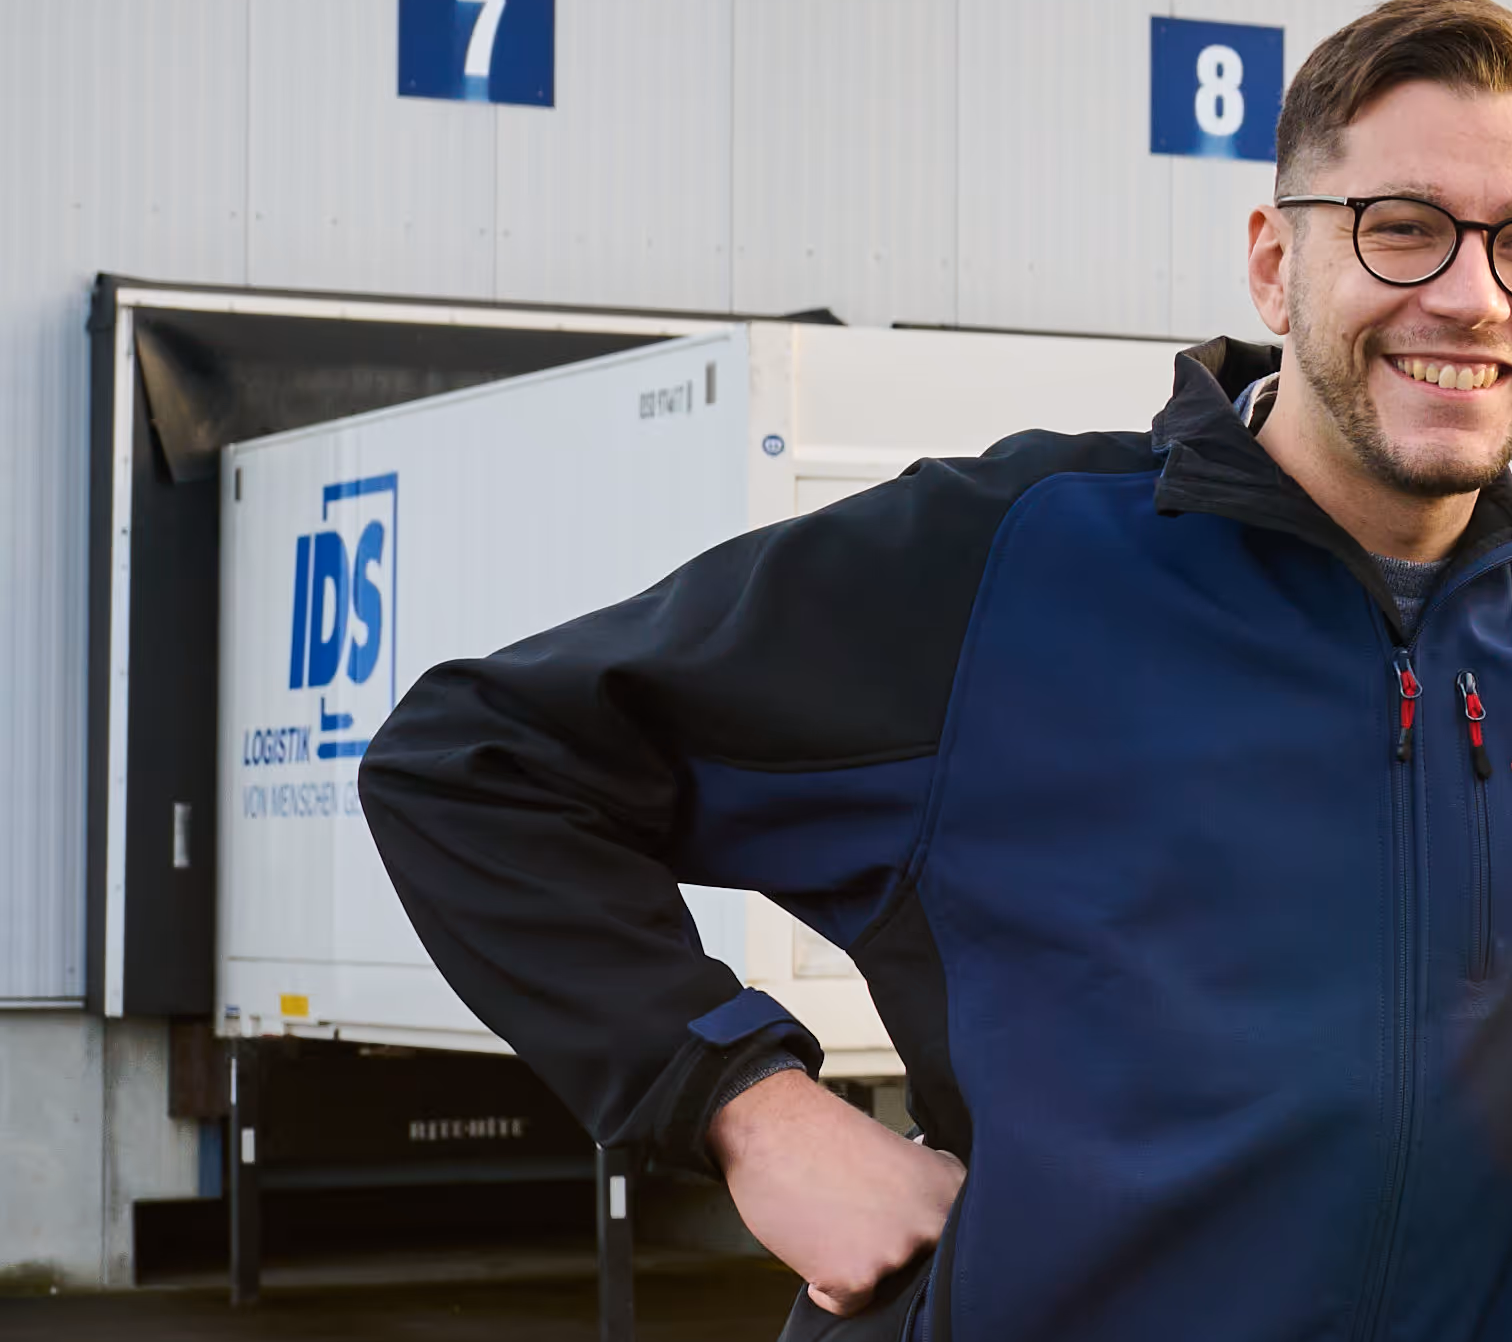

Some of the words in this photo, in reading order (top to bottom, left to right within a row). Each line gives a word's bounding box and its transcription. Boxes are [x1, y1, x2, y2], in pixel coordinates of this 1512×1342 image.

[1194, 44, 1245, 136] 8
[289, 519, 385, 690] IDS
[243, 725, 311, 766] LOGISTIK
[243, 784, 267, 819] VON
[271, 781, 337, 817] MENSCHEN
